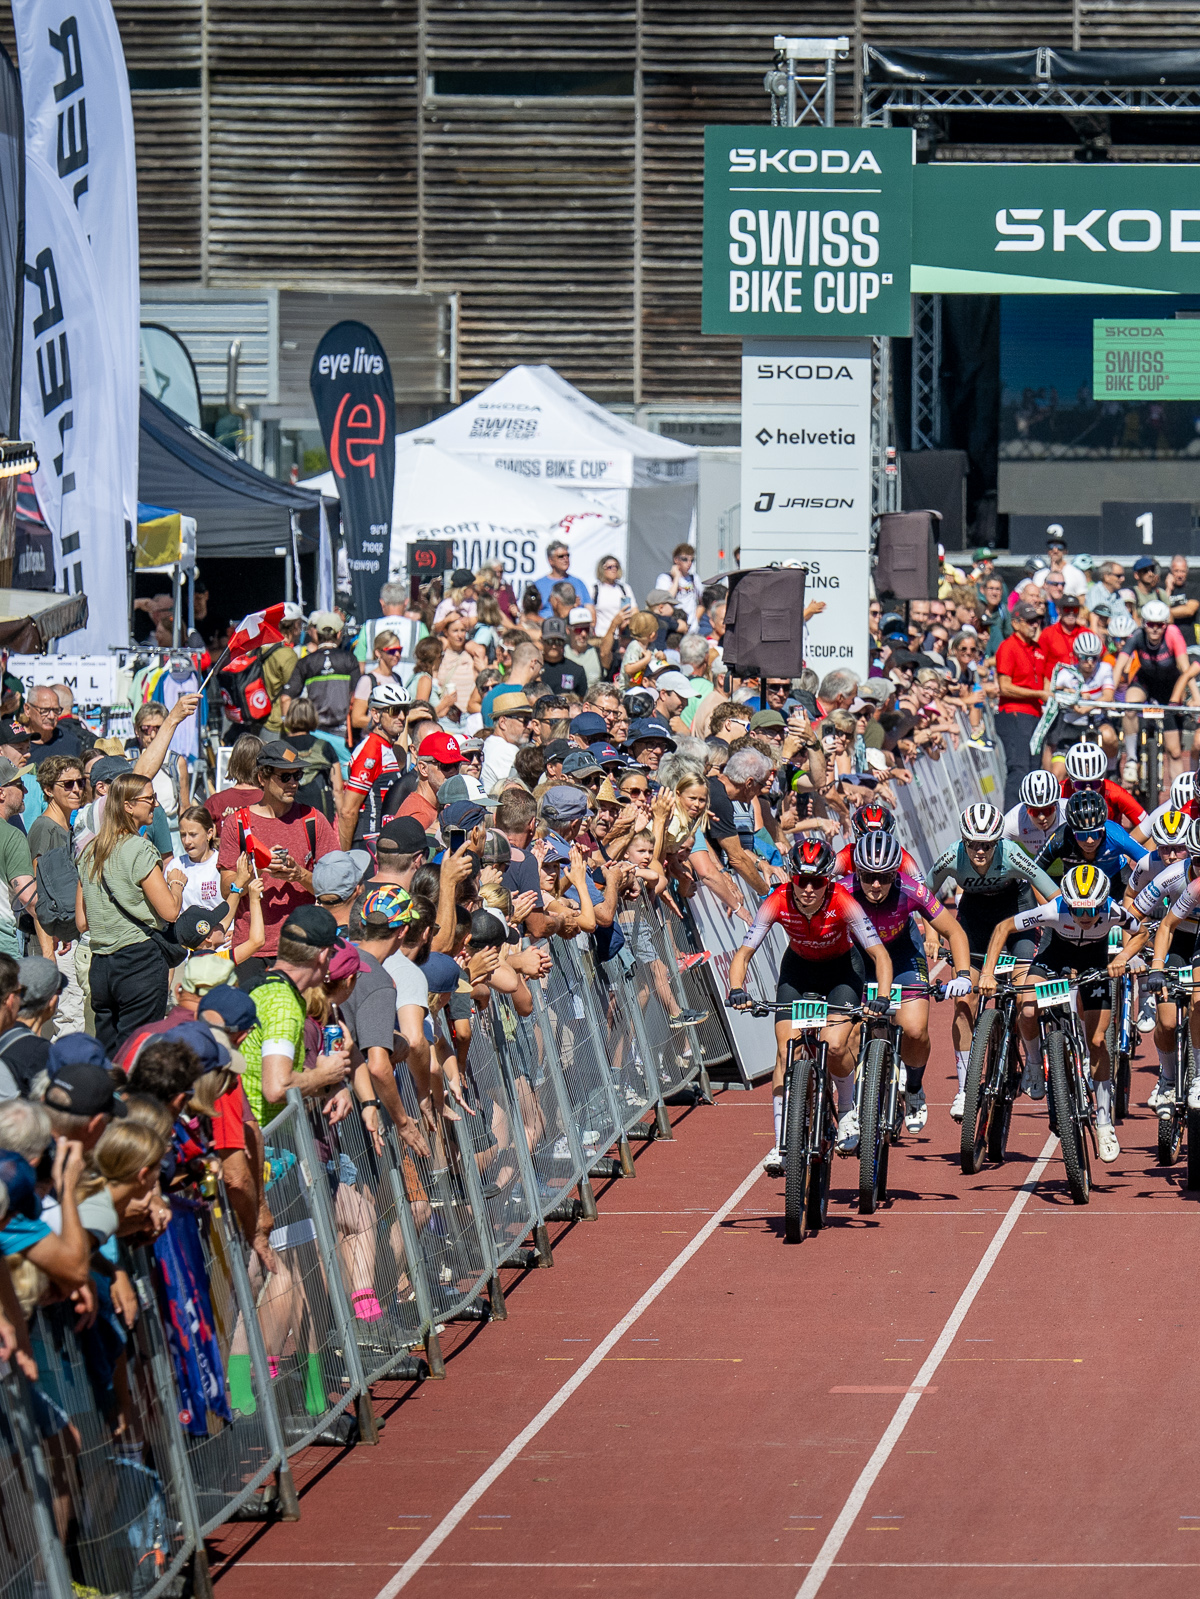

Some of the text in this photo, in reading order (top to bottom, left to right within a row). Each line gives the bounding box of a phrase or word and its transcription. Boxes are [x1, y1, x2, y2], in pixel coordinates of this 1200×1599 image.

[728, 208, 880, 267] SWISS
[729, 271, 880, 314] BIKE CUP
[1105, 351, 1164, 374] SWISS
[1105, 375, 1164, 392] BIKE CUP
[473, 417, 538, 431] SWISS
[469, 429, 500, 438] BIKE
[776, 429, 856, 445] helvetia
[545, 459, 575, 478] BIKE
[581, 460, 607, 478] CUP
[778, 498, 854, 509] JAISON
[1135, 512, 1153, 545] 1
[64, 676, 77, 688] M
[90, 676, 98, 688] L
[963, 876, 1006, 888] ROSE
[1022, 914, 1044, 928] BMC
[1037, 980, 1070, 997] 1101
[793, 1002, 825, 1019] 1104
